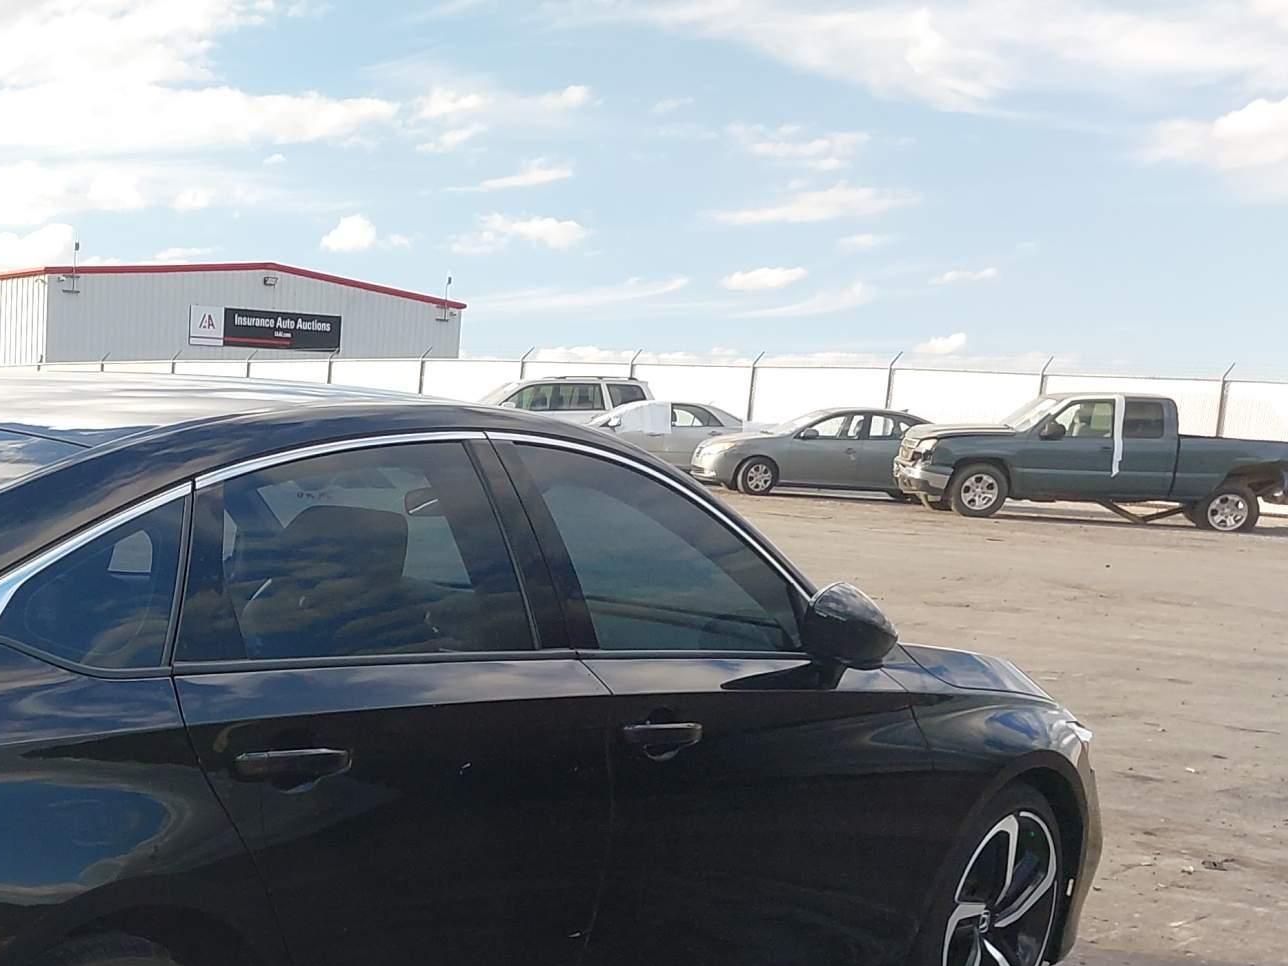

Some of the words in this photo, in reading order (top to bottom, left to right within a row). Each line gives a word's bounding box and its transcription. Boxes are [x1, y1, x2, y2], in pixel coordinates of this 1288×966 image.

[234, 313, 274, 328] Insurance
[276, 316, 294, 329] Auto
[296, 317, 331, 332] Auctions
